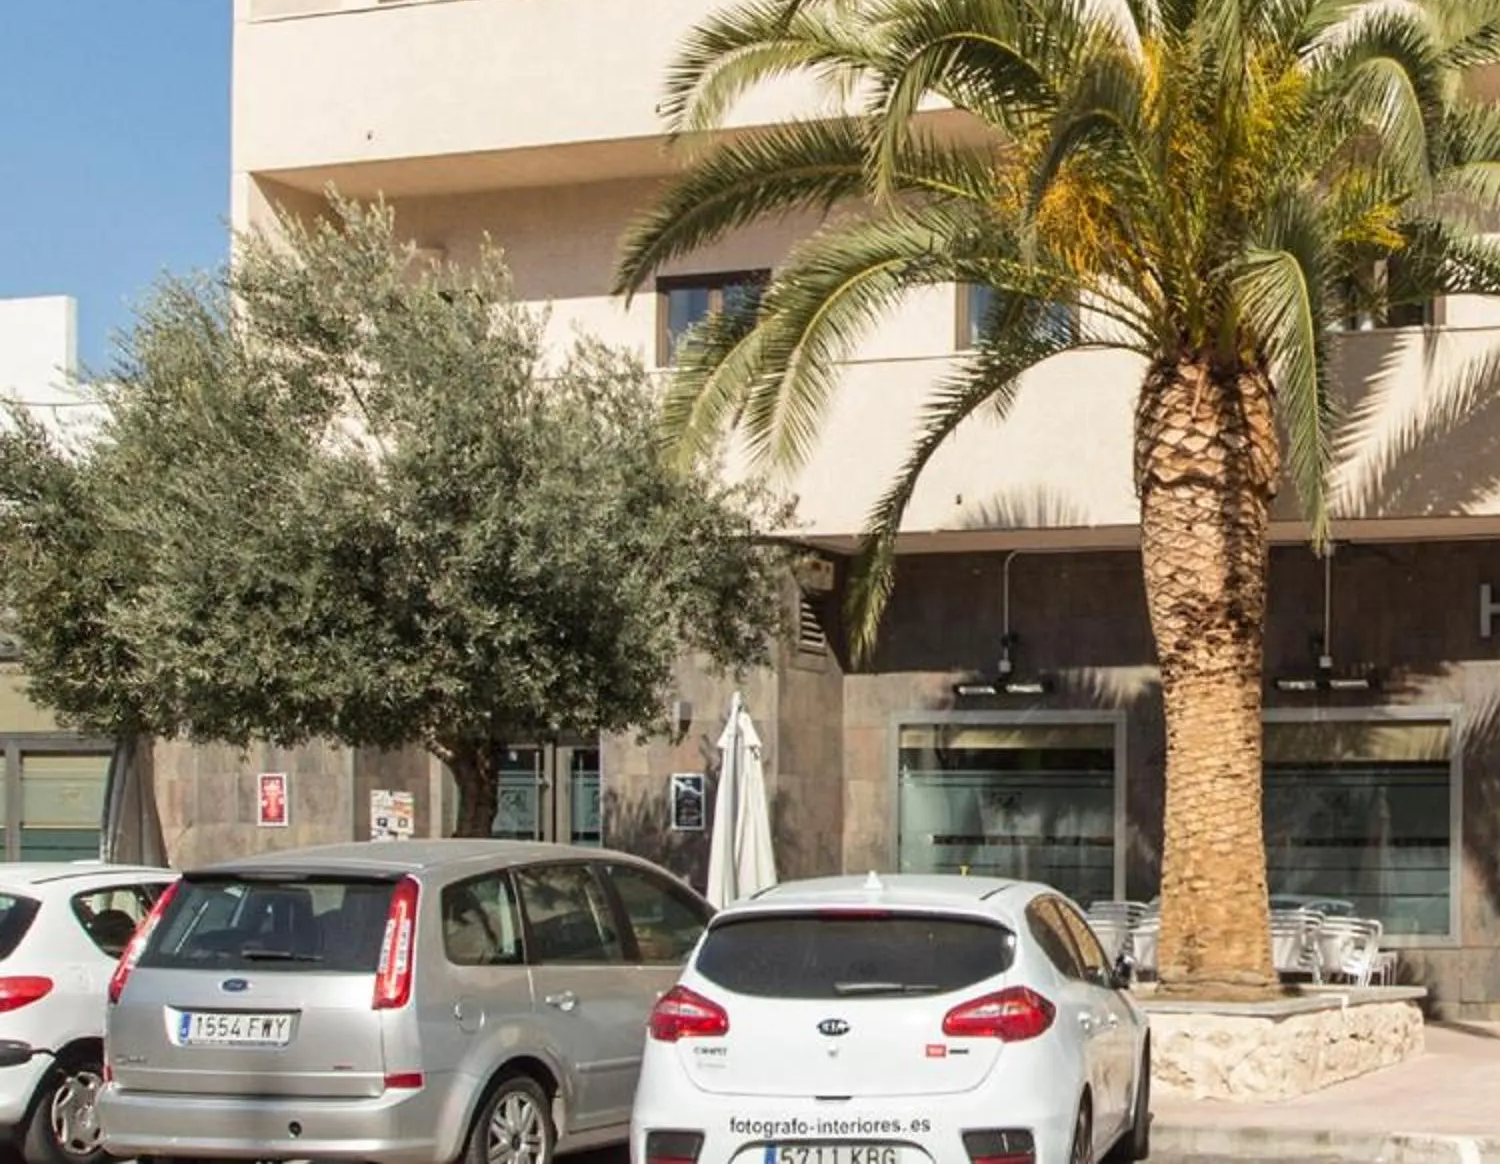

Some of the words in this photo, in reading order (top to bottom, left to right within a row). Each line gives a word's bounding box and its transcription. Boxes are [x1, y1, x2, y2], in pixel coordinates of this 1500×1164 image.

[196, 1016, 241, 1037] 1554
[247, 1017, 287, 1038] FWY
[729, 1117, 931, 1138] fotografo-interiores.es
